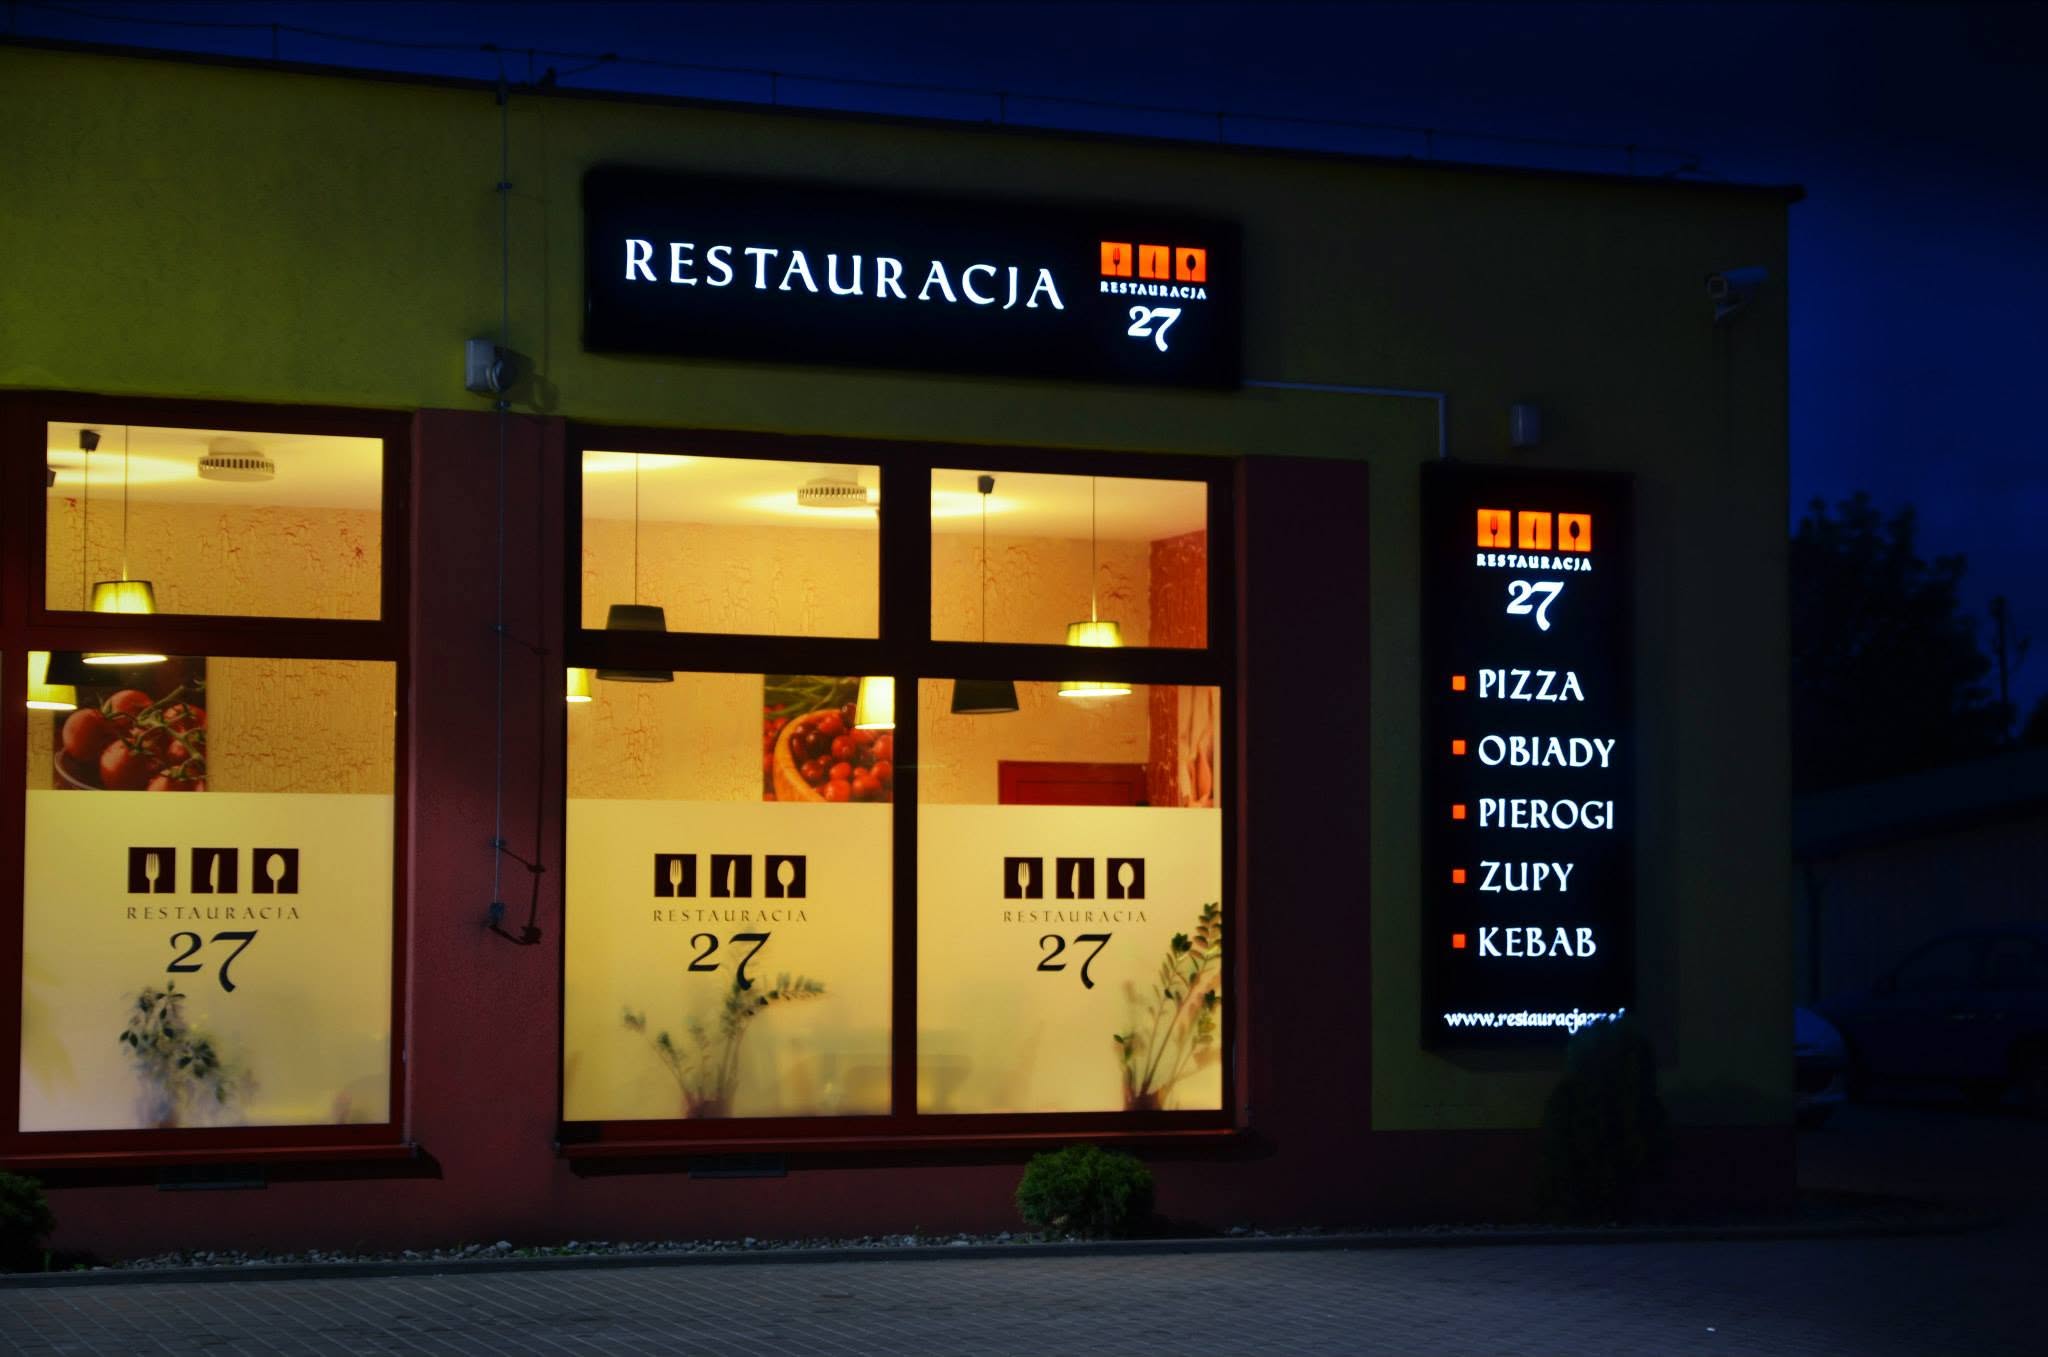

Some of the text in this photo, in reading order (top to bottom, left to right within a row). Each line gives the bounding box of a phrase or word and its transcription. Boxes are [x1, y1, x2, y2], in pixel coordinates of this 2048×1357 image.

[626, 239, 1064, 309] RESTAURACJA
[1100, 281, 1207, 300] RESTAURACJA
[1128, 306, 1181, 352] 27
[1477, 553, 1593, 571] RESTAURACJA
[1507, 580, 1564, 631] 27
[1479, 669, 1584, 702] PIZZA
[1479, 735, 1615, 767] OBIADY
[1479, 798, 1613, 829] PIEROGI
[1480, 861, 1574, 893] ZUPY
[1479, 927, 1596, 957] KEBAB
[166, 930, 258, 993] 27
[687, 931, 772, 991] 27
[1037, 932, 1113, 990] 27
